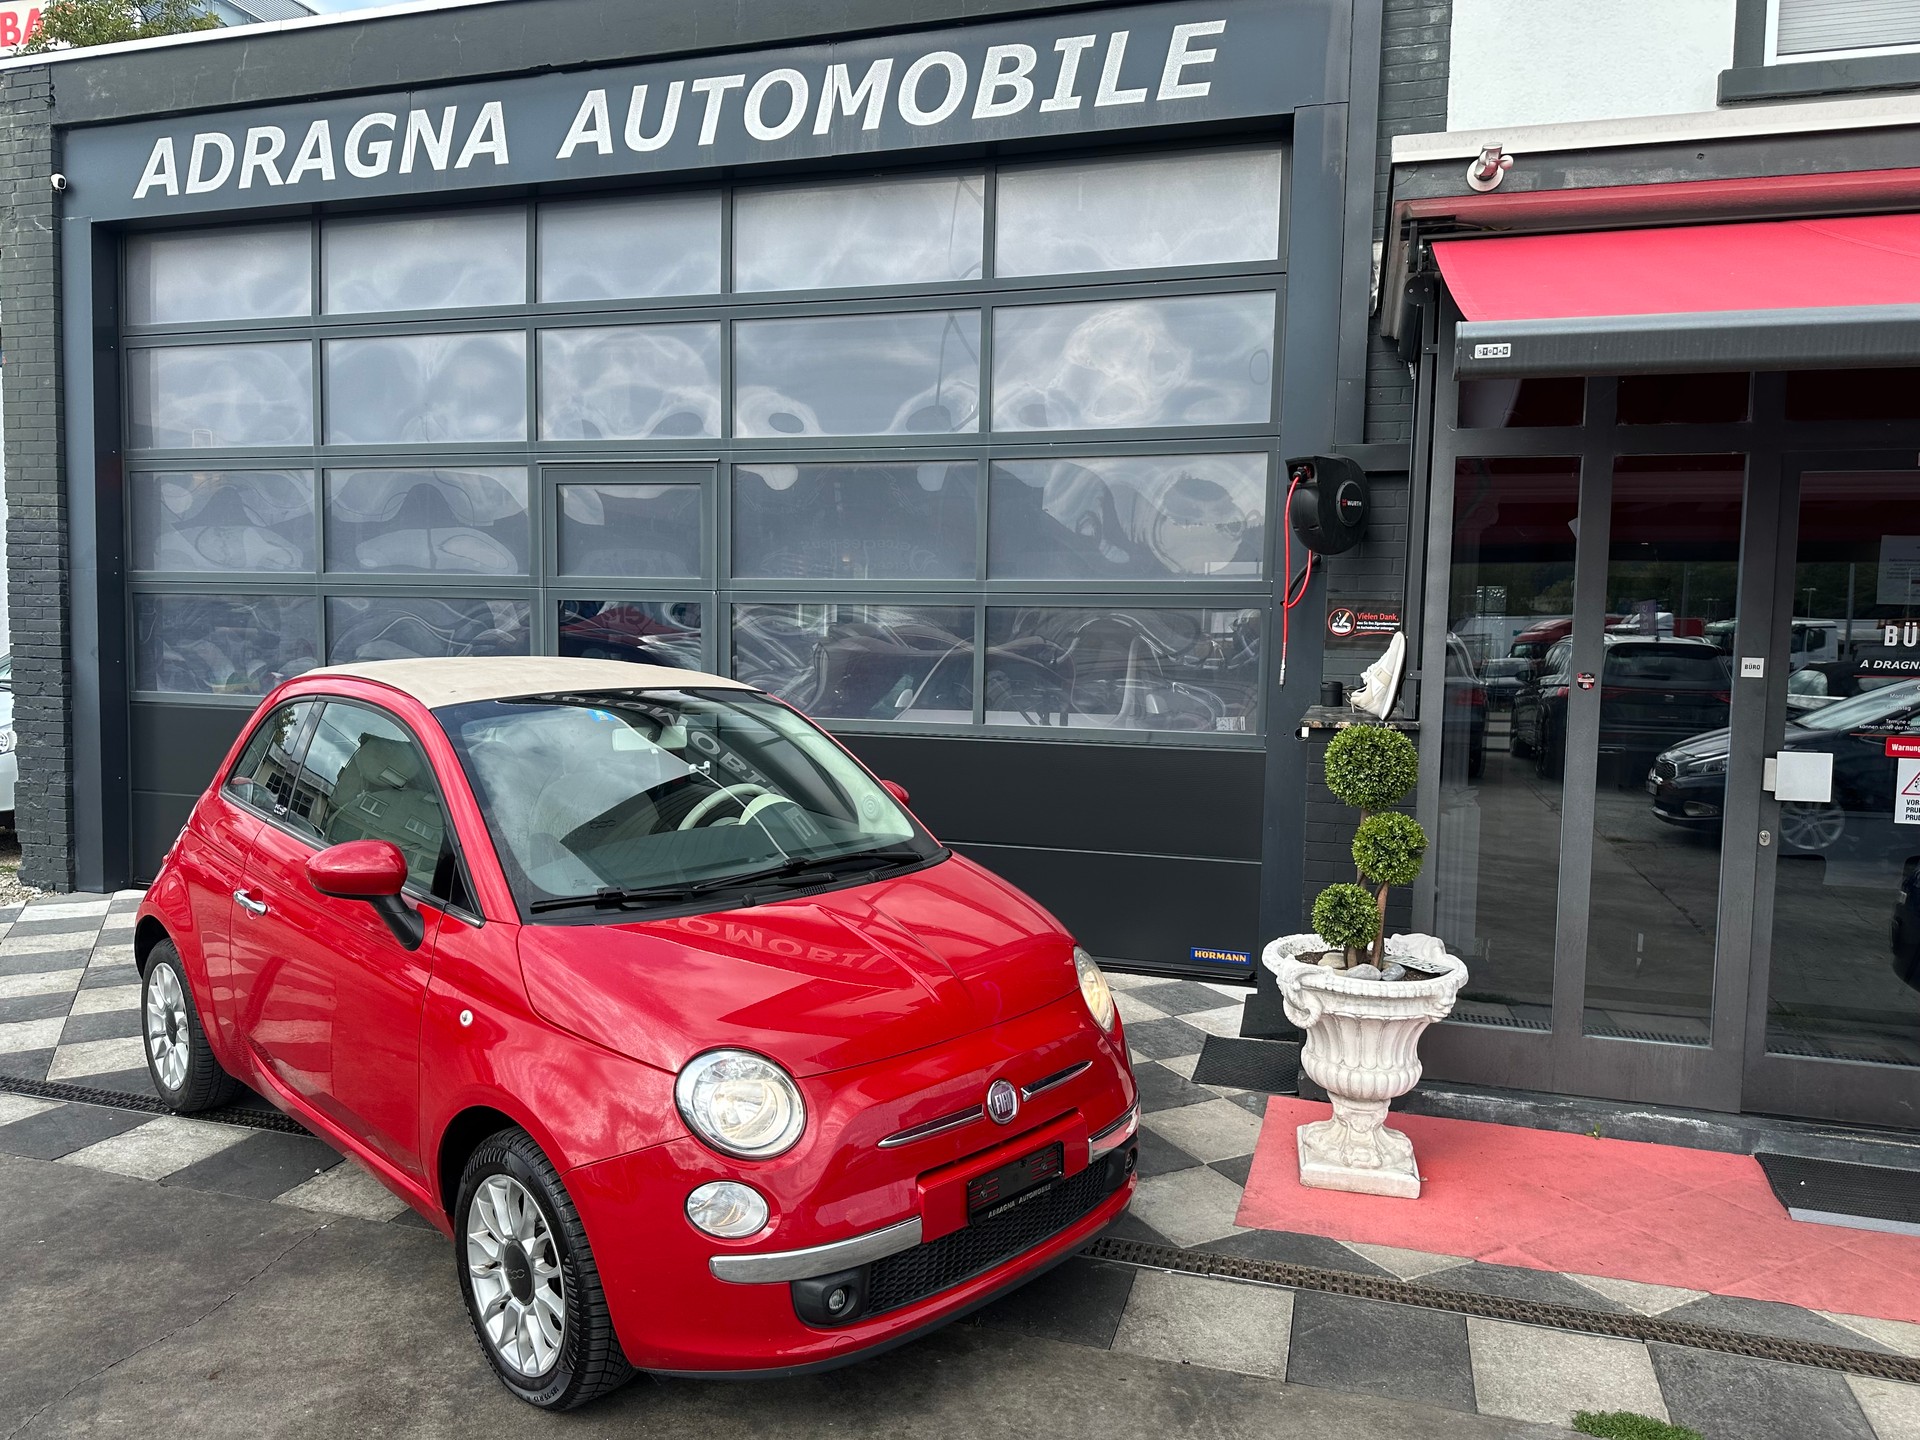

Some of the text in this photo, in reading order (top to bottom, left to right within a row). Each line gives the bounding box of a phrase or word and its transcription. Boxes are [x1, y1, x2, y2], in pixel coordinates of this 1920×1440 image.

[0, 7, 45, 47] BA
[132, 19, 1228, 200] ADRAGNA AUTOMOBILE
[1357, 612, 1399, 621] Vielen Dank,
[1884, 621, 1918, 647] BÜ
[994, 1089, 1012, 1115] FIAT
[1018, 1183, 1052, 1204] AUTOMOBILE
